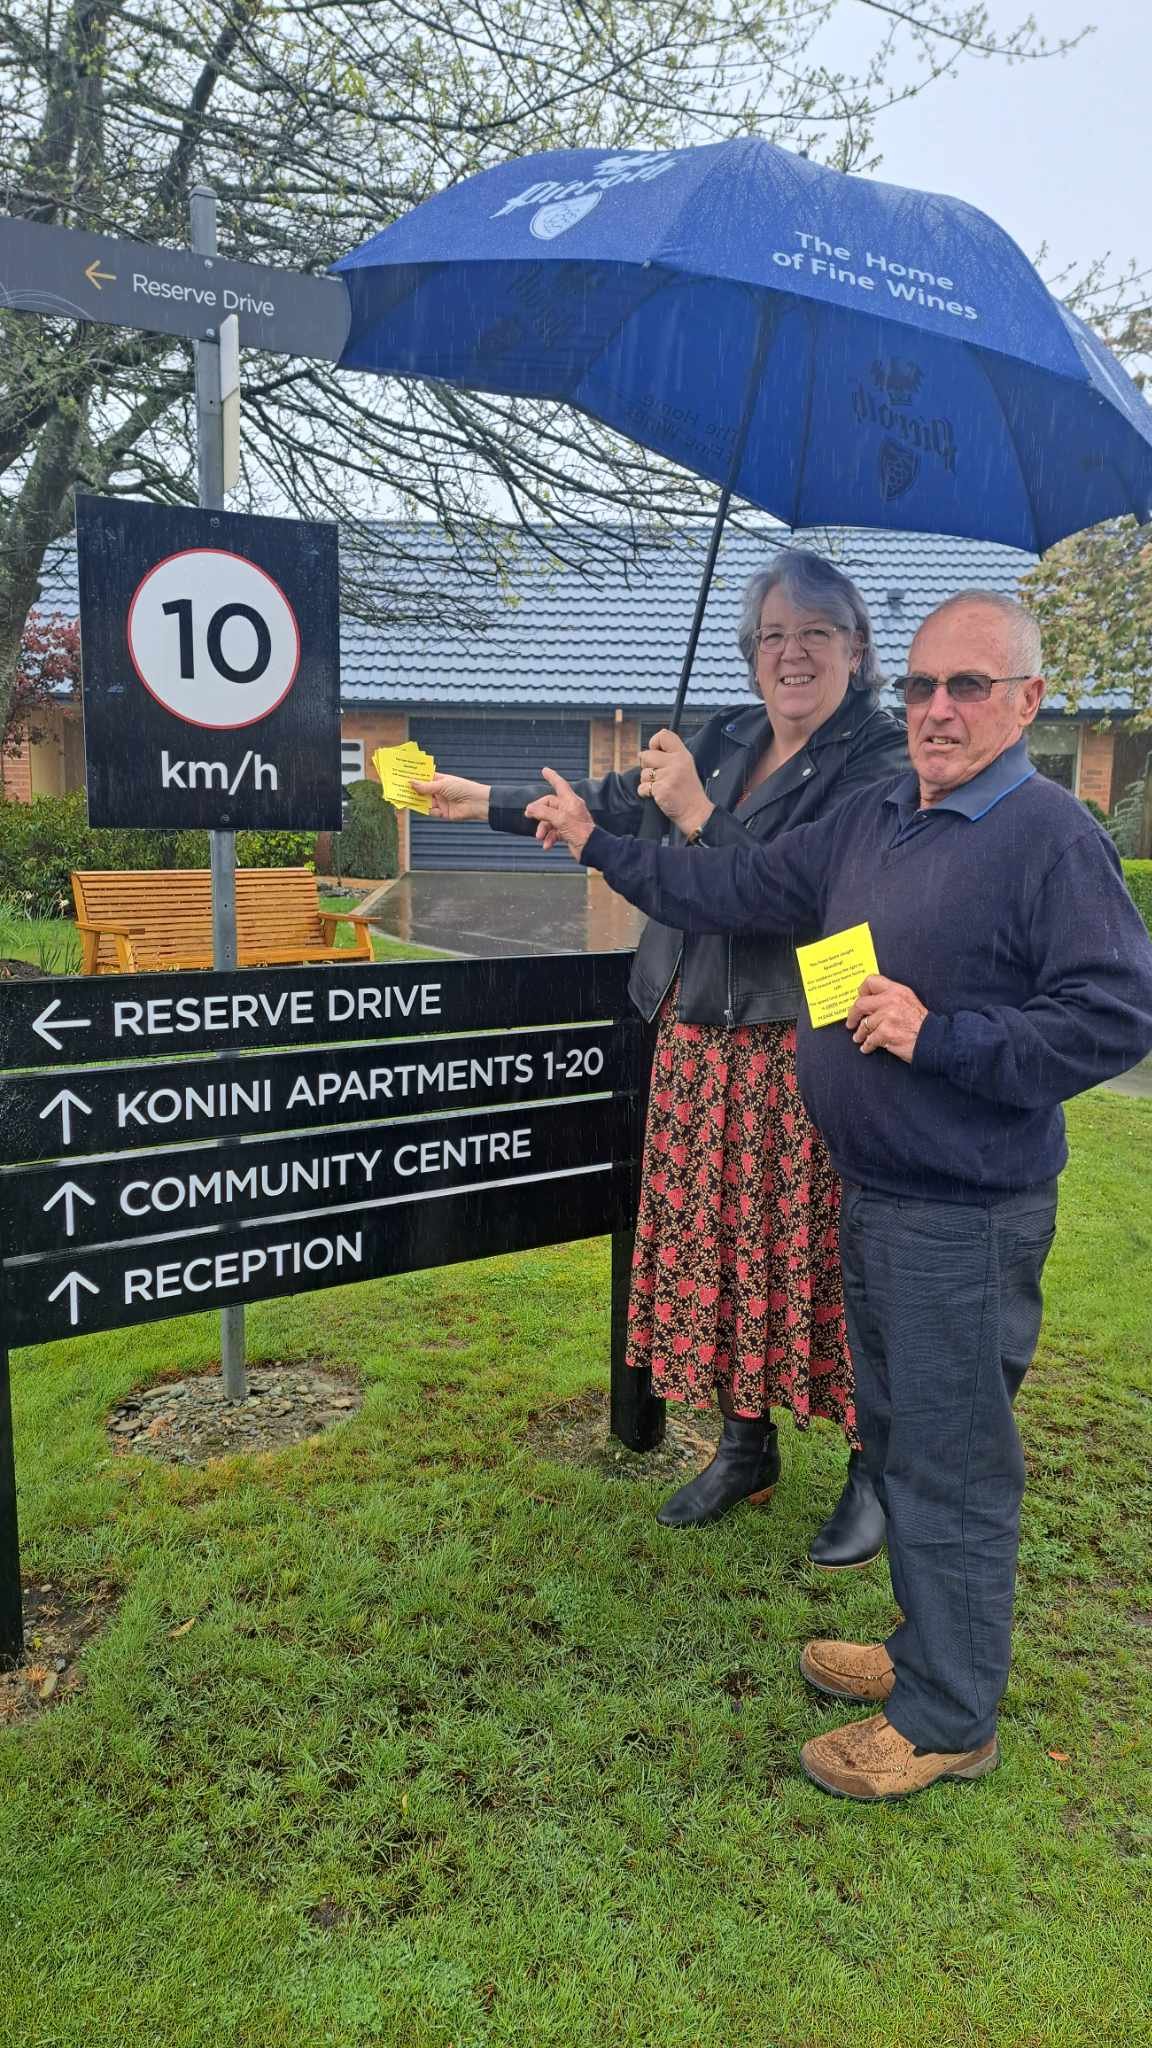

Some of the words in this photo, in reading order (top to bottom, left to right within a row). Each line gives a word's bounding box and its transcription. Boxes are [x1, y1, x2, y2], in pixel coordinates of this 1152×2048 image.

[133, 273, 216, 306] Reserve
[223, 290, 274, 316] Drive
[772, 251, 804, 270] of
[811, 258, 875, 290] Fine
[886, 279, 978, 320] Wines
[795, 231, 850, 260] The
[866, 252, 954, 290] Home
[162, 598, 271, 684] 10
[161, 750, 278, 796] km/h
[113, 991, 314, 1037] RESERVE
[329, 983, 442, 1023] DRIVE
[117, 1080, 271, 1128] KONINI
[286, 1053, 533, 1110] APARTMENTS
[543, 1047, 604, 1081] 1-20
[119, 1149, 382, 1217] COMMUNITY
[393, 1128, 533, 1177] CENTRE
[123, 1231, 363, 1305] RECEPTION
